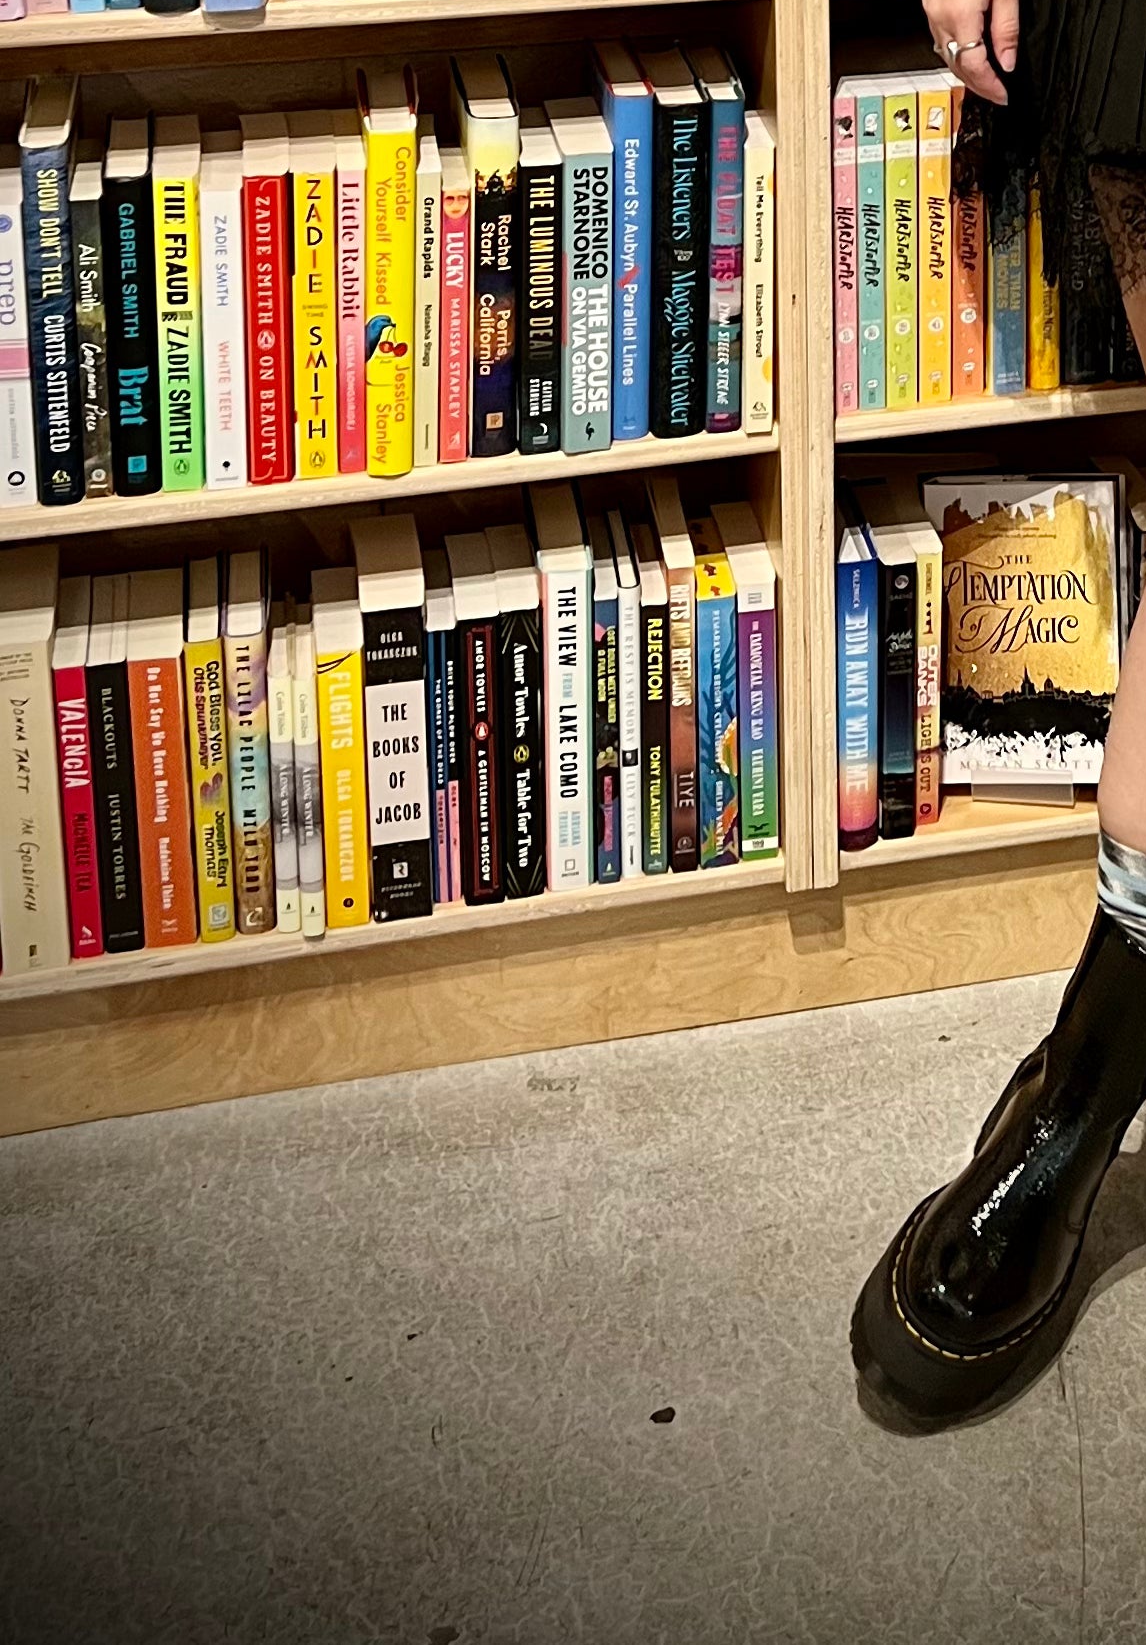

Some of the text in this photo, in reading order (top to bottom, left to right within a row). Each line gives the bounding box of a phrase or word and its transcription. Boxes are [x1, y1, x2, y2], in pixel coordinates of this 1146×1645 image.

[163, 181, 189, 305] THE FRAUD
[482, 222, 493, 265] Stark
[497, 214, 511, 270] Rachel
[530, 175, 553, 312] THE LUMINOUS
[574, 169, 590, 280] STARNONE
[592, 167, 608, 279] DOMENICO
[118, 203, 139, 338] GABRIEL SMITH
[118, 366, 148, 426] Brat
[166, 327, 193, 454] ZADIE SMITH
[589, 324, 608, 413] HOUSE
[944, 559, 1099, 606] TEMPTATION
[1005, 555, 1032, 565] THE
[558, 587, 578, 798] THE VIEW LAKE COMO
[648, 619, 663, 700] REJECTION
[58, 698, 91, 789] VALENCIA
[328, 672, 353, 749] FLIGHTS
[372, 734, 418, 755] BOOKS
[382, 705, 407, 720] THE
[389, 772, 405, 789] OF
[959, 758, 1093, 770] MEGAN SCOTT
[377, 802, 422, 823] JACOB
